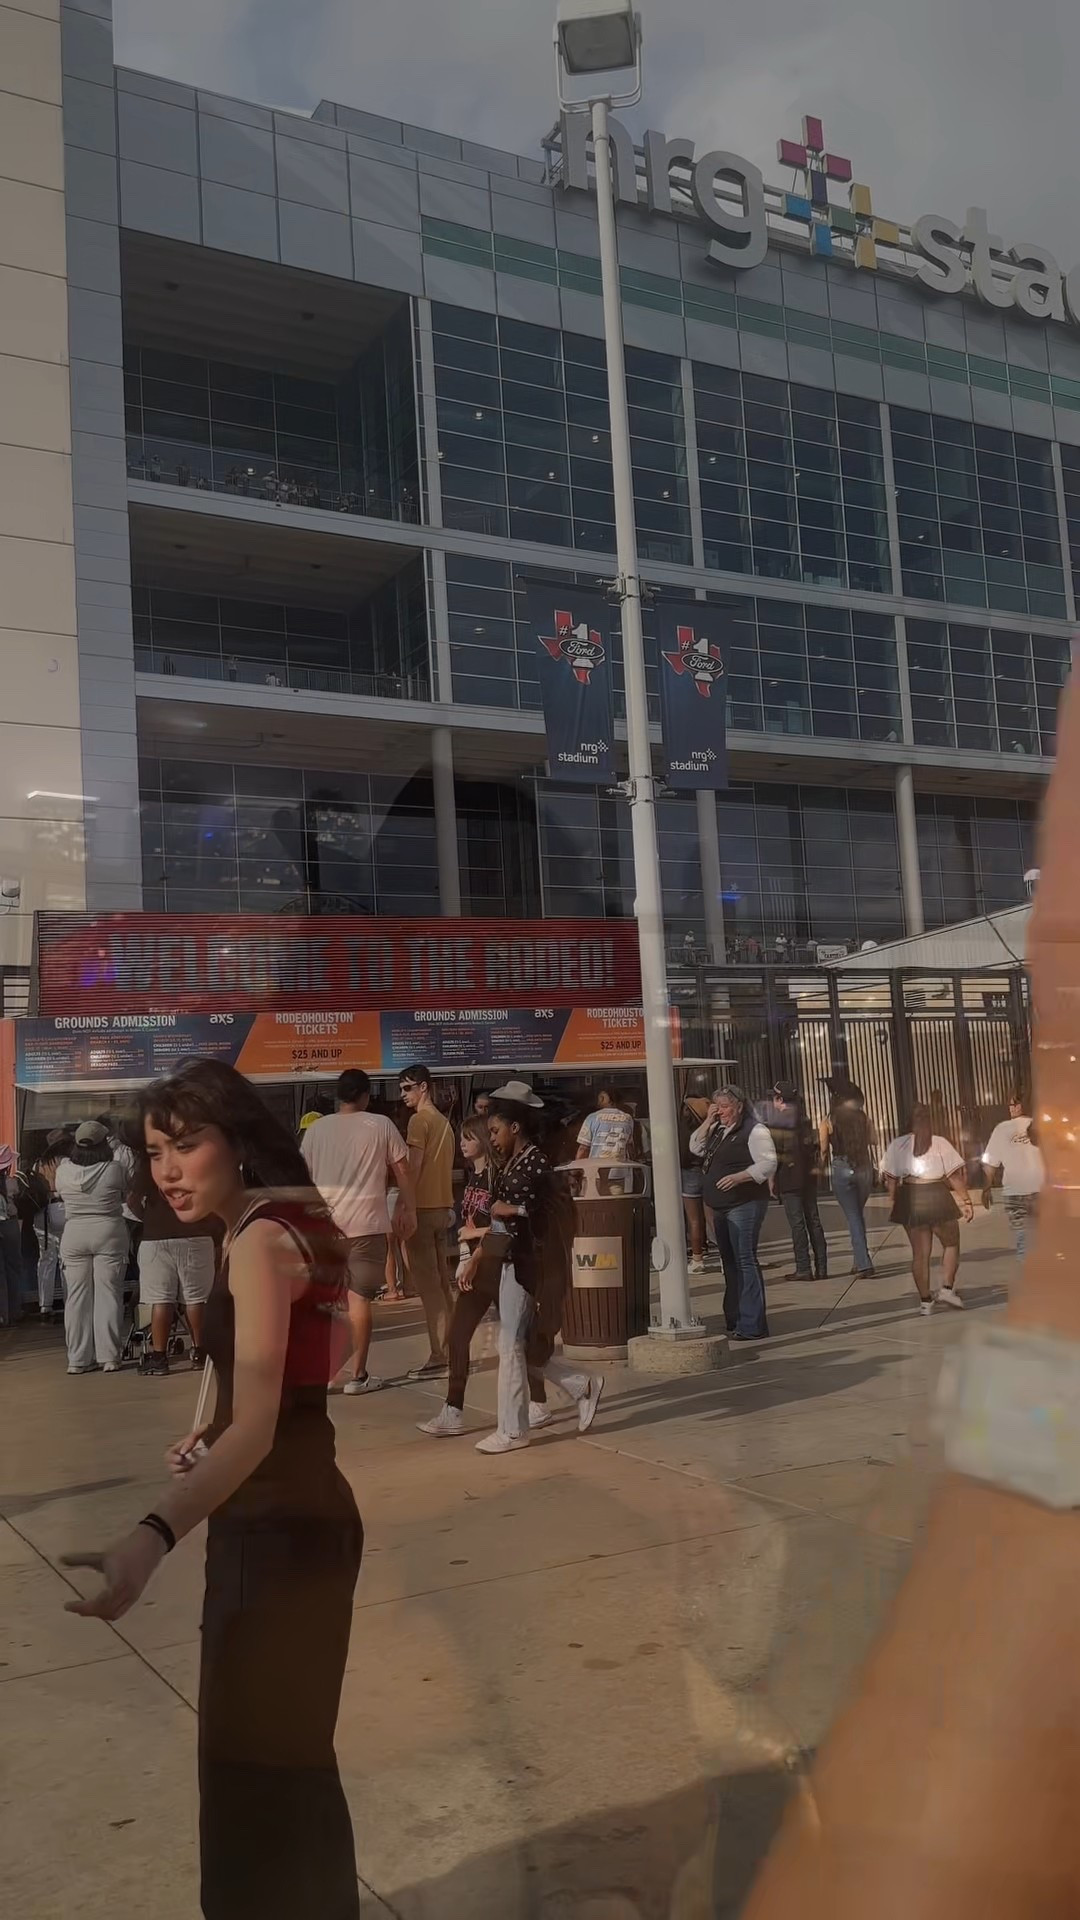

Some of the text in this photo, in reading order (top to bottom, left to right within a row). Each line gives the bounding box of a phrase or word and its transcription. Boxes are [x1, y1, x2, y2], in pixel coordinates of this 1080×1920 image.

[561, 111, 770, 270] nrg
[567, 641, 595, 657] Ford
[690, 656, 715, 670] Ford
[581, 742, 598, 754] nrg
[558, 752, 598, 764] stadium
[692, 752, 707, 762] nrg
[670, 760, 709, 771] stadium
[109, 934, 614, 991] WELCOME TO THE RODEO!
[210, 1013, 234, 1026] axs
[276, 1012, 354, 1024] RODEOHOUSTON
[414, 1009, 508, 1022] GROUNDS ADMISSION
[535, 1009, 554, 1019] axs
[54, 1015, 176, 1030] GROUNDS ADMISSION
[602, 1018, 638, 1028] TICKETS
[294, 1024, 338, 1035] TICKETS
[600, 1040, 642, 1051] $25 AND UP
[292, 1047, 343, 1059] $25 AND UP
[576, 1253, 617, 1267] WM
